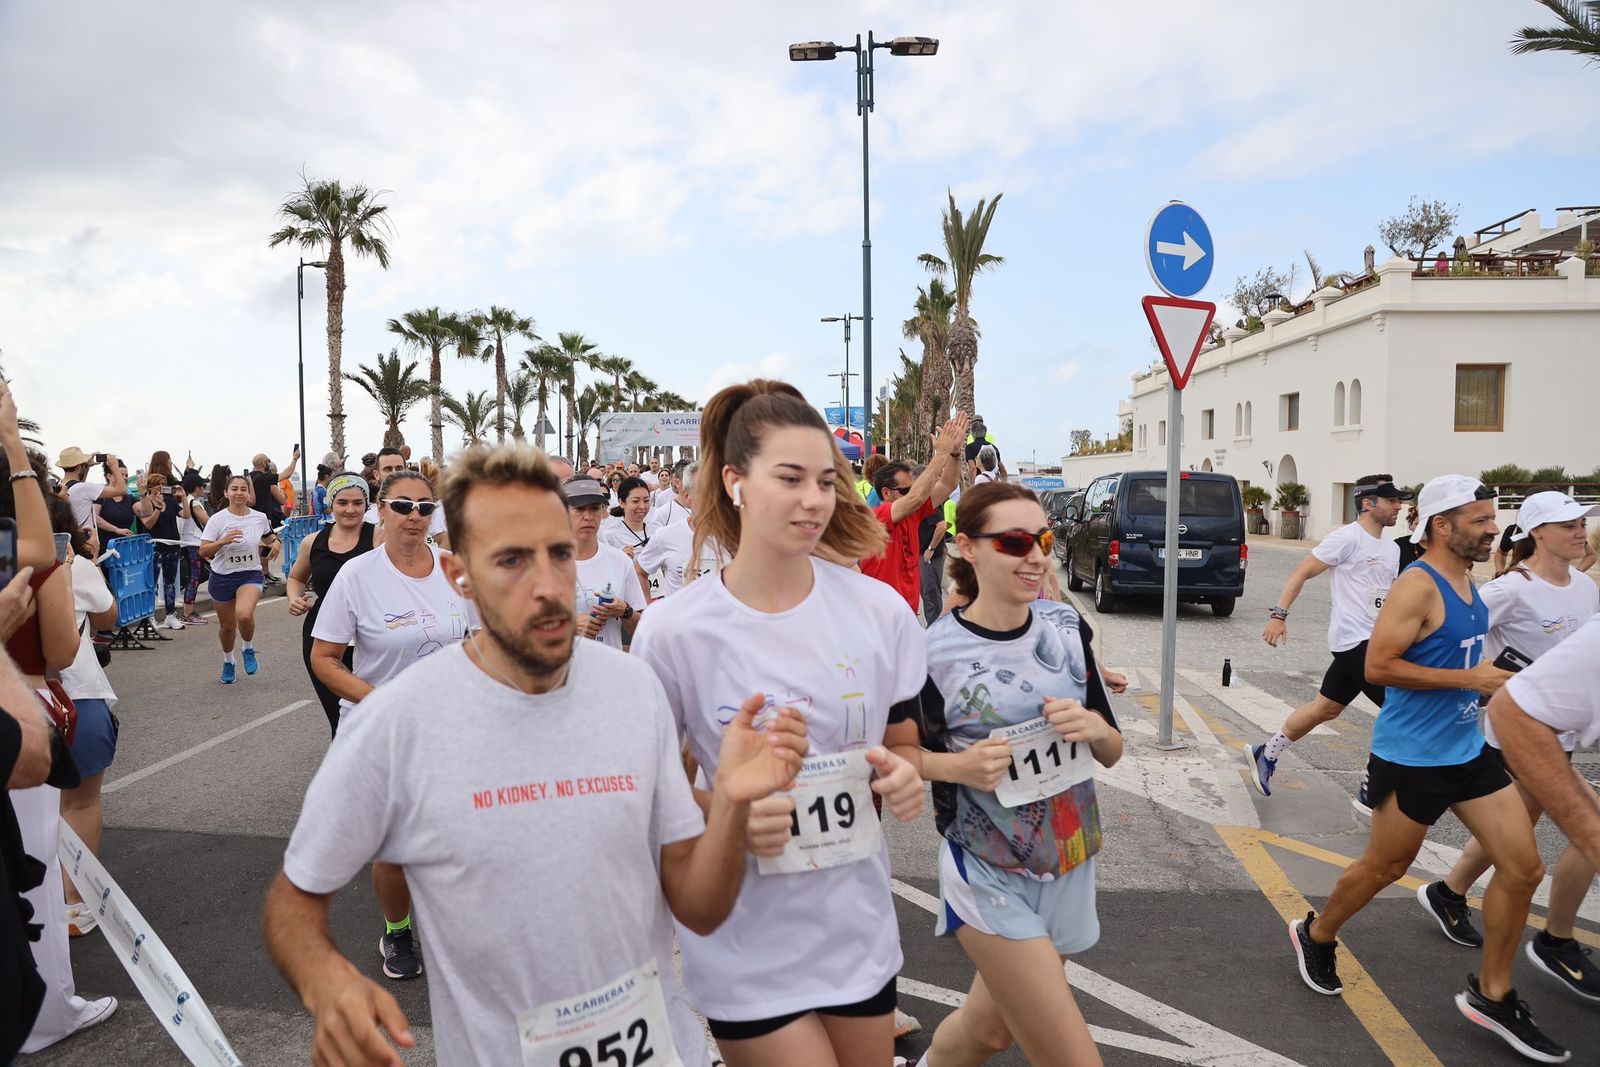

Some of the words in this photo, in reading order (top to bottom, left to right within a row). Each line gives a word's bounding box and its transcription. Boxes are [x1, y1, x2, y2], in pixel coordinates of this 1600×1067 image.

[228, 554, 253, 563] 1311
[1018, 720, 1049, 734] CARRER
[473, 790, 493, 809] NO
[555, 779, 574, 798] NO
[555, 1006, 571, 1018] 3A
[573, 986, 624, 1013] CARRERA
